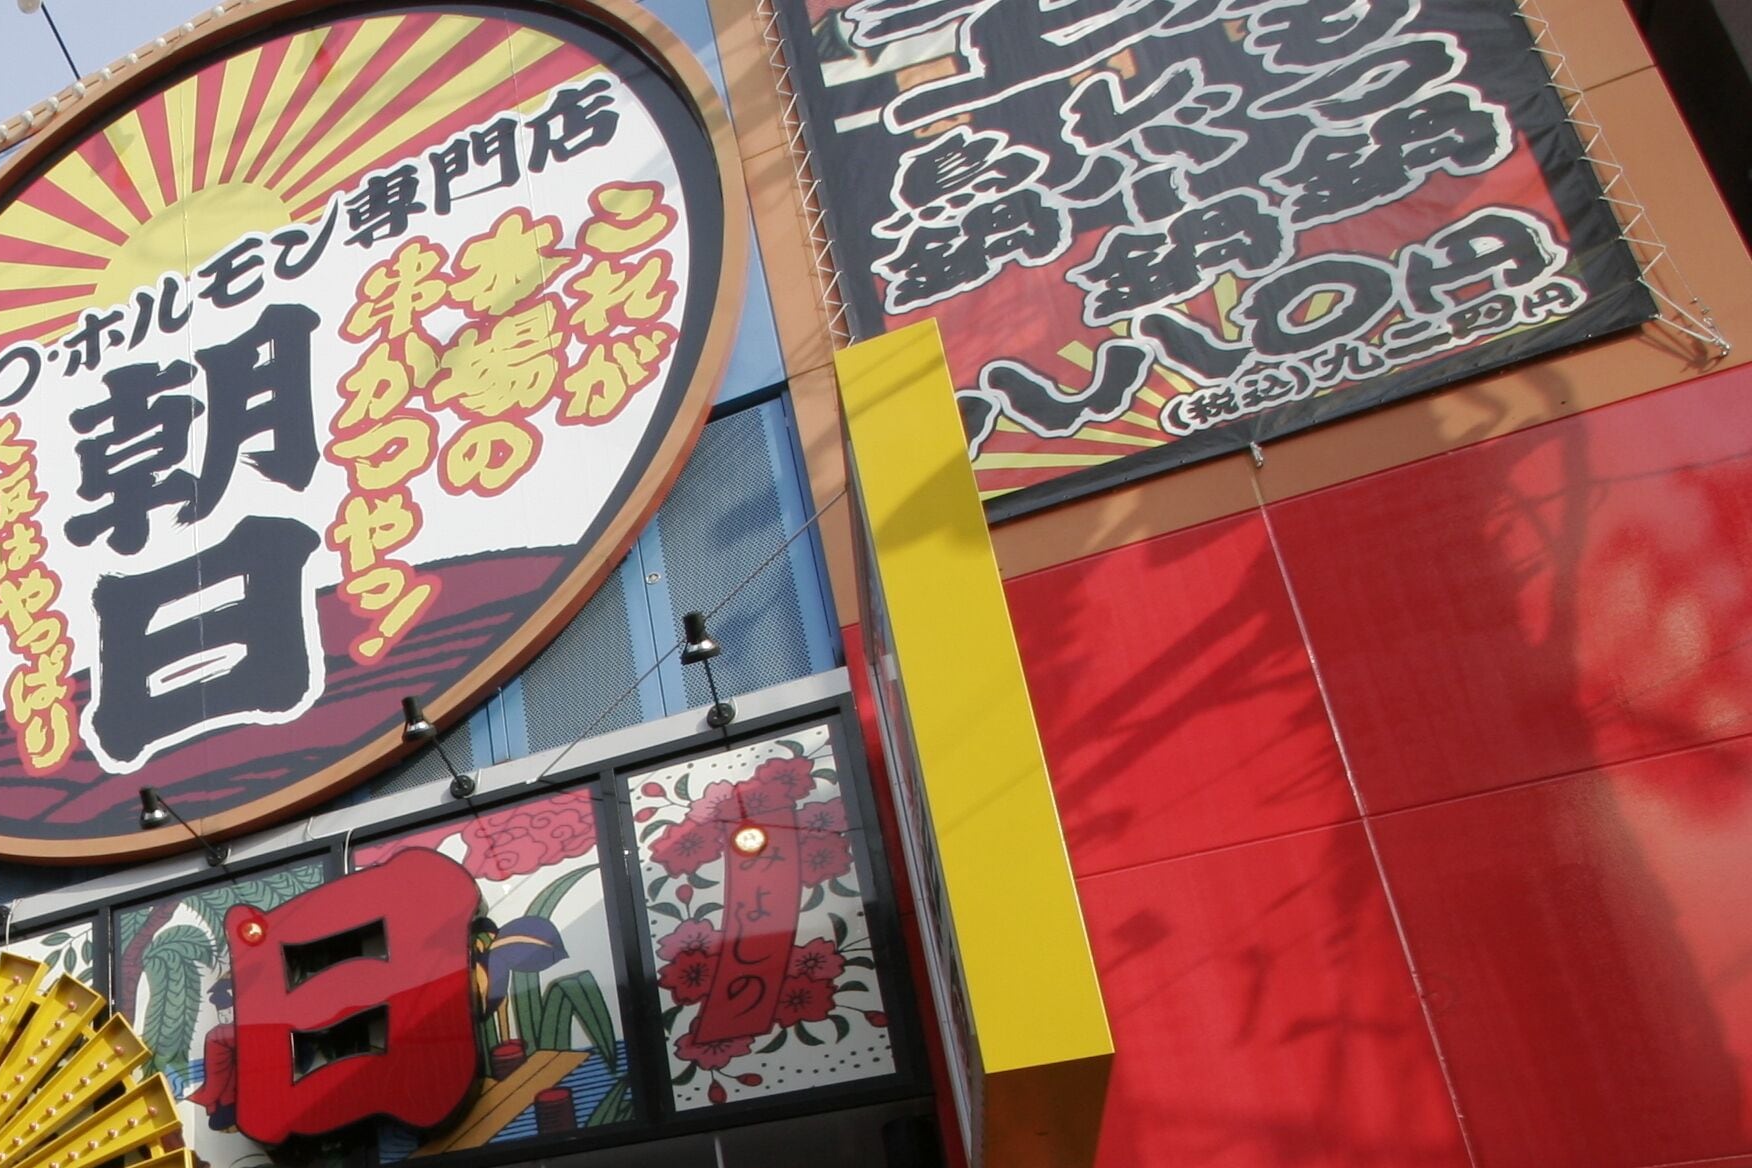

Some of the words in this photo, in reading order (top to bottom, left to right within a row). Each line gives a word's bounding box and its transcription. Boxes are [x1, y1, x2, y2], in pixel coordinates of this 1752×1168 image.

[434, 208, 574, 494] 本場の
[558, 180, 680, 425] これが
[65, 305, 322, 765] 朝日
